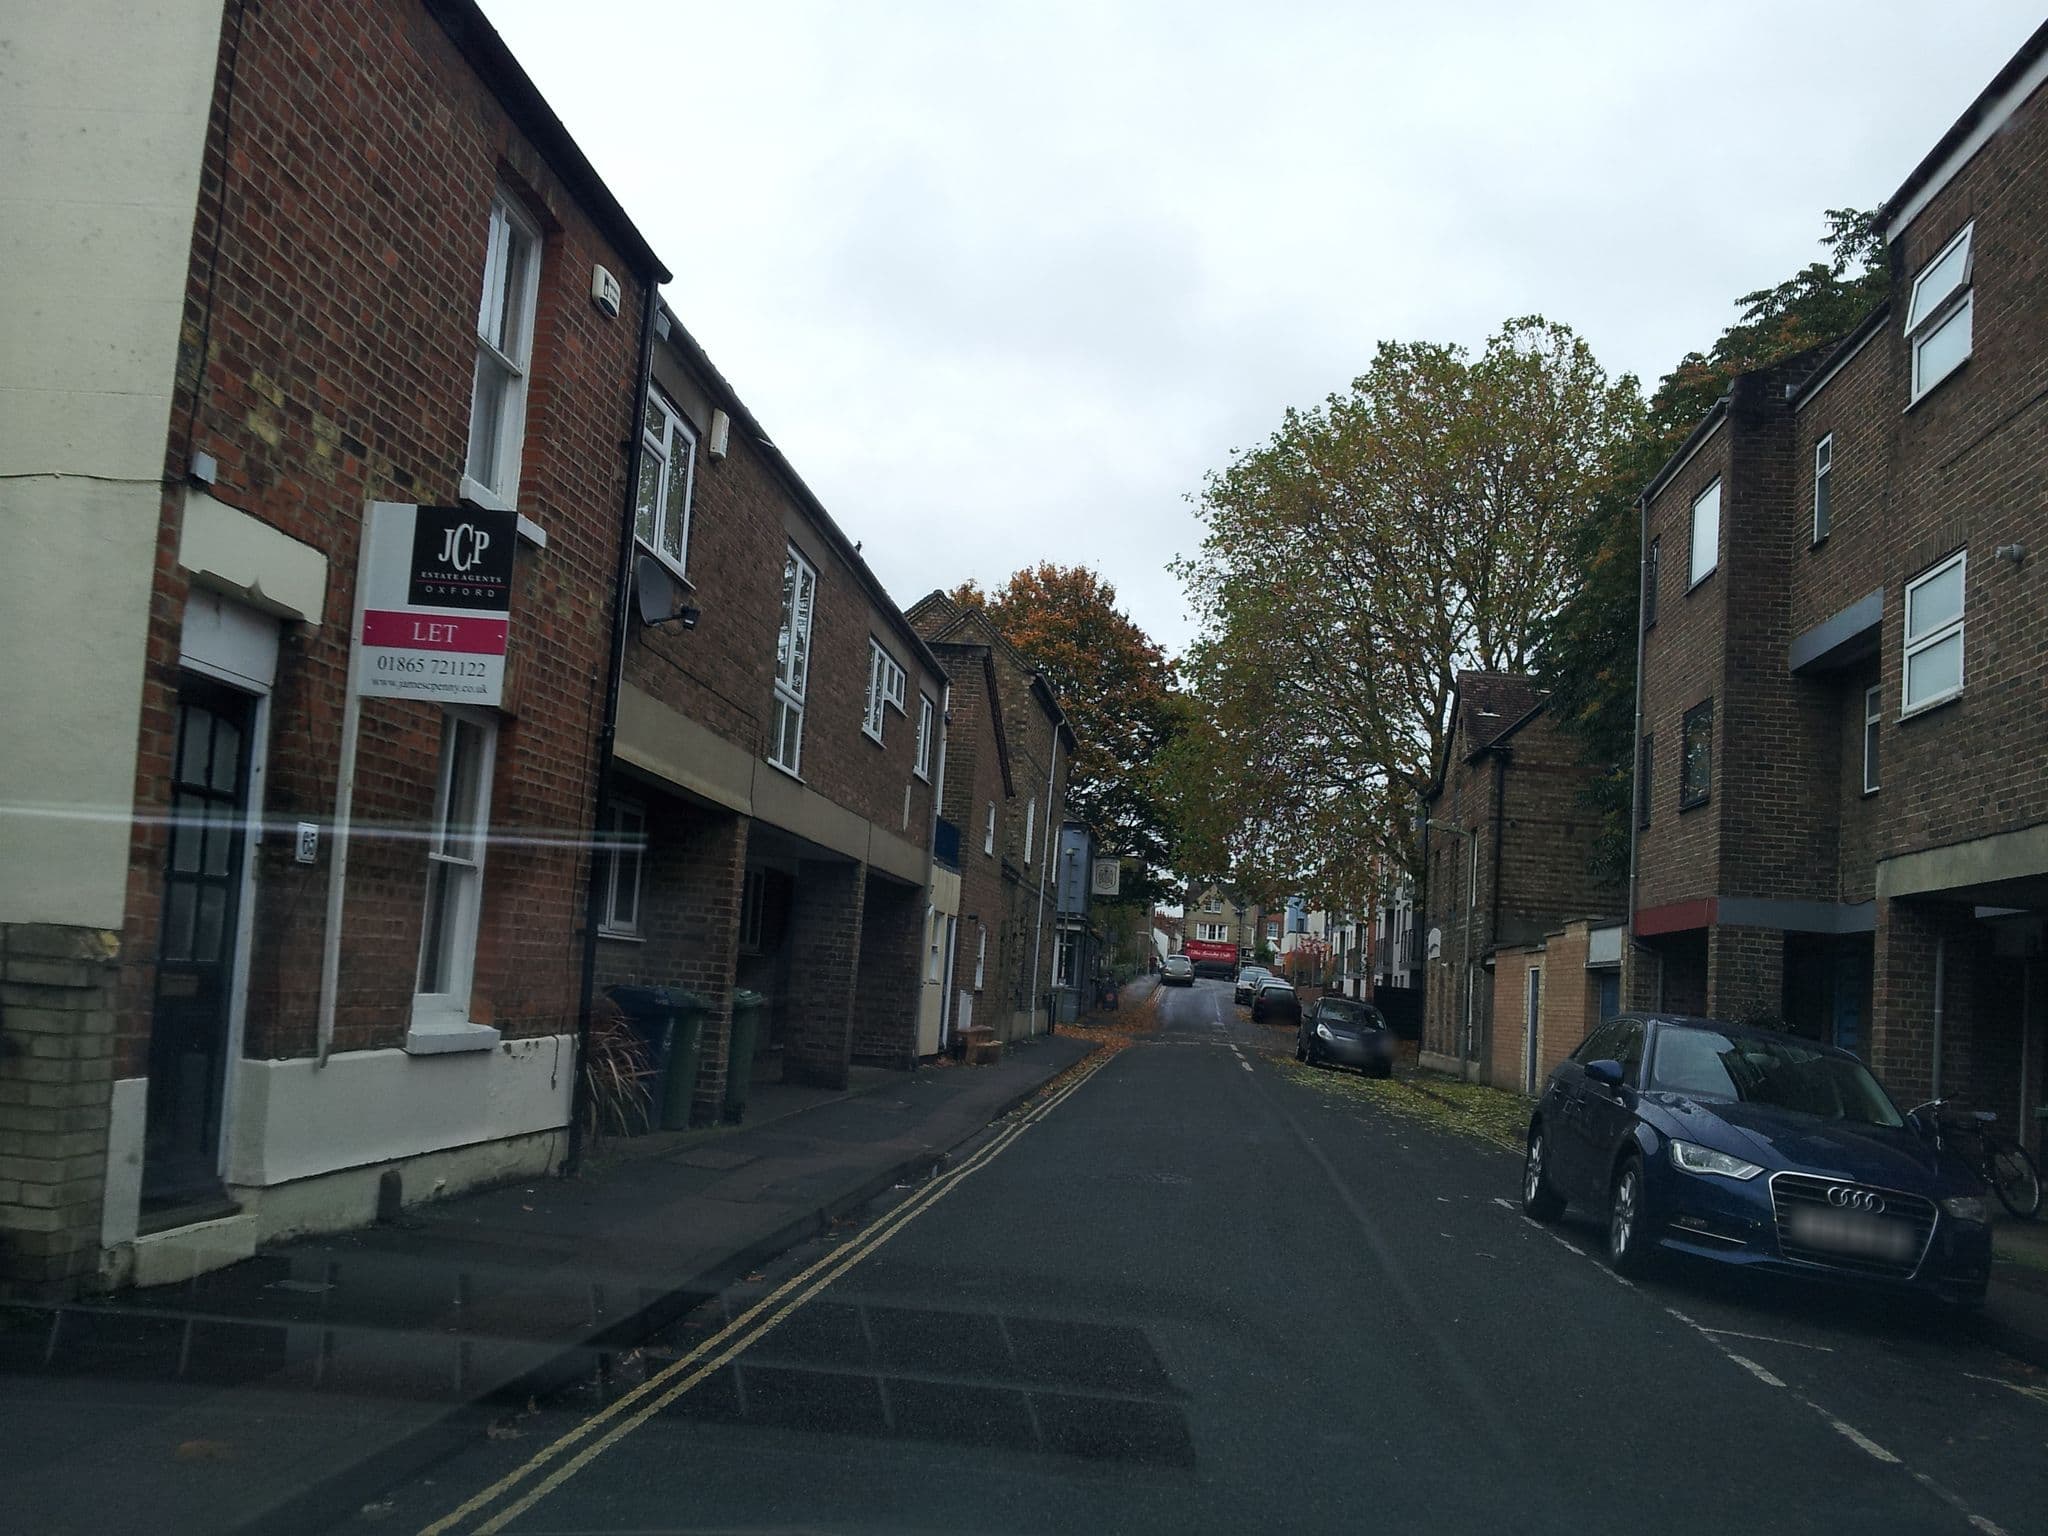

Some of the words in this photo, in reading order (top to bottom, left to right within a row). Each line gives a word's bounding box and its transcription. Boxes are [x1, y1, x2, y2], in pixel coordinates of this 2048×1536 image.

[438, 523, 490, 571] JCP
[421, 571, 459, 580] ESTATE
[462, 574, 502, 583] AGENTS
[425, 585, 495, 598] OXFORD
[412, 622, 458, 643] LET
[377, 655, 425, 673] 01865
[431, 659, 486, 677] 721122
